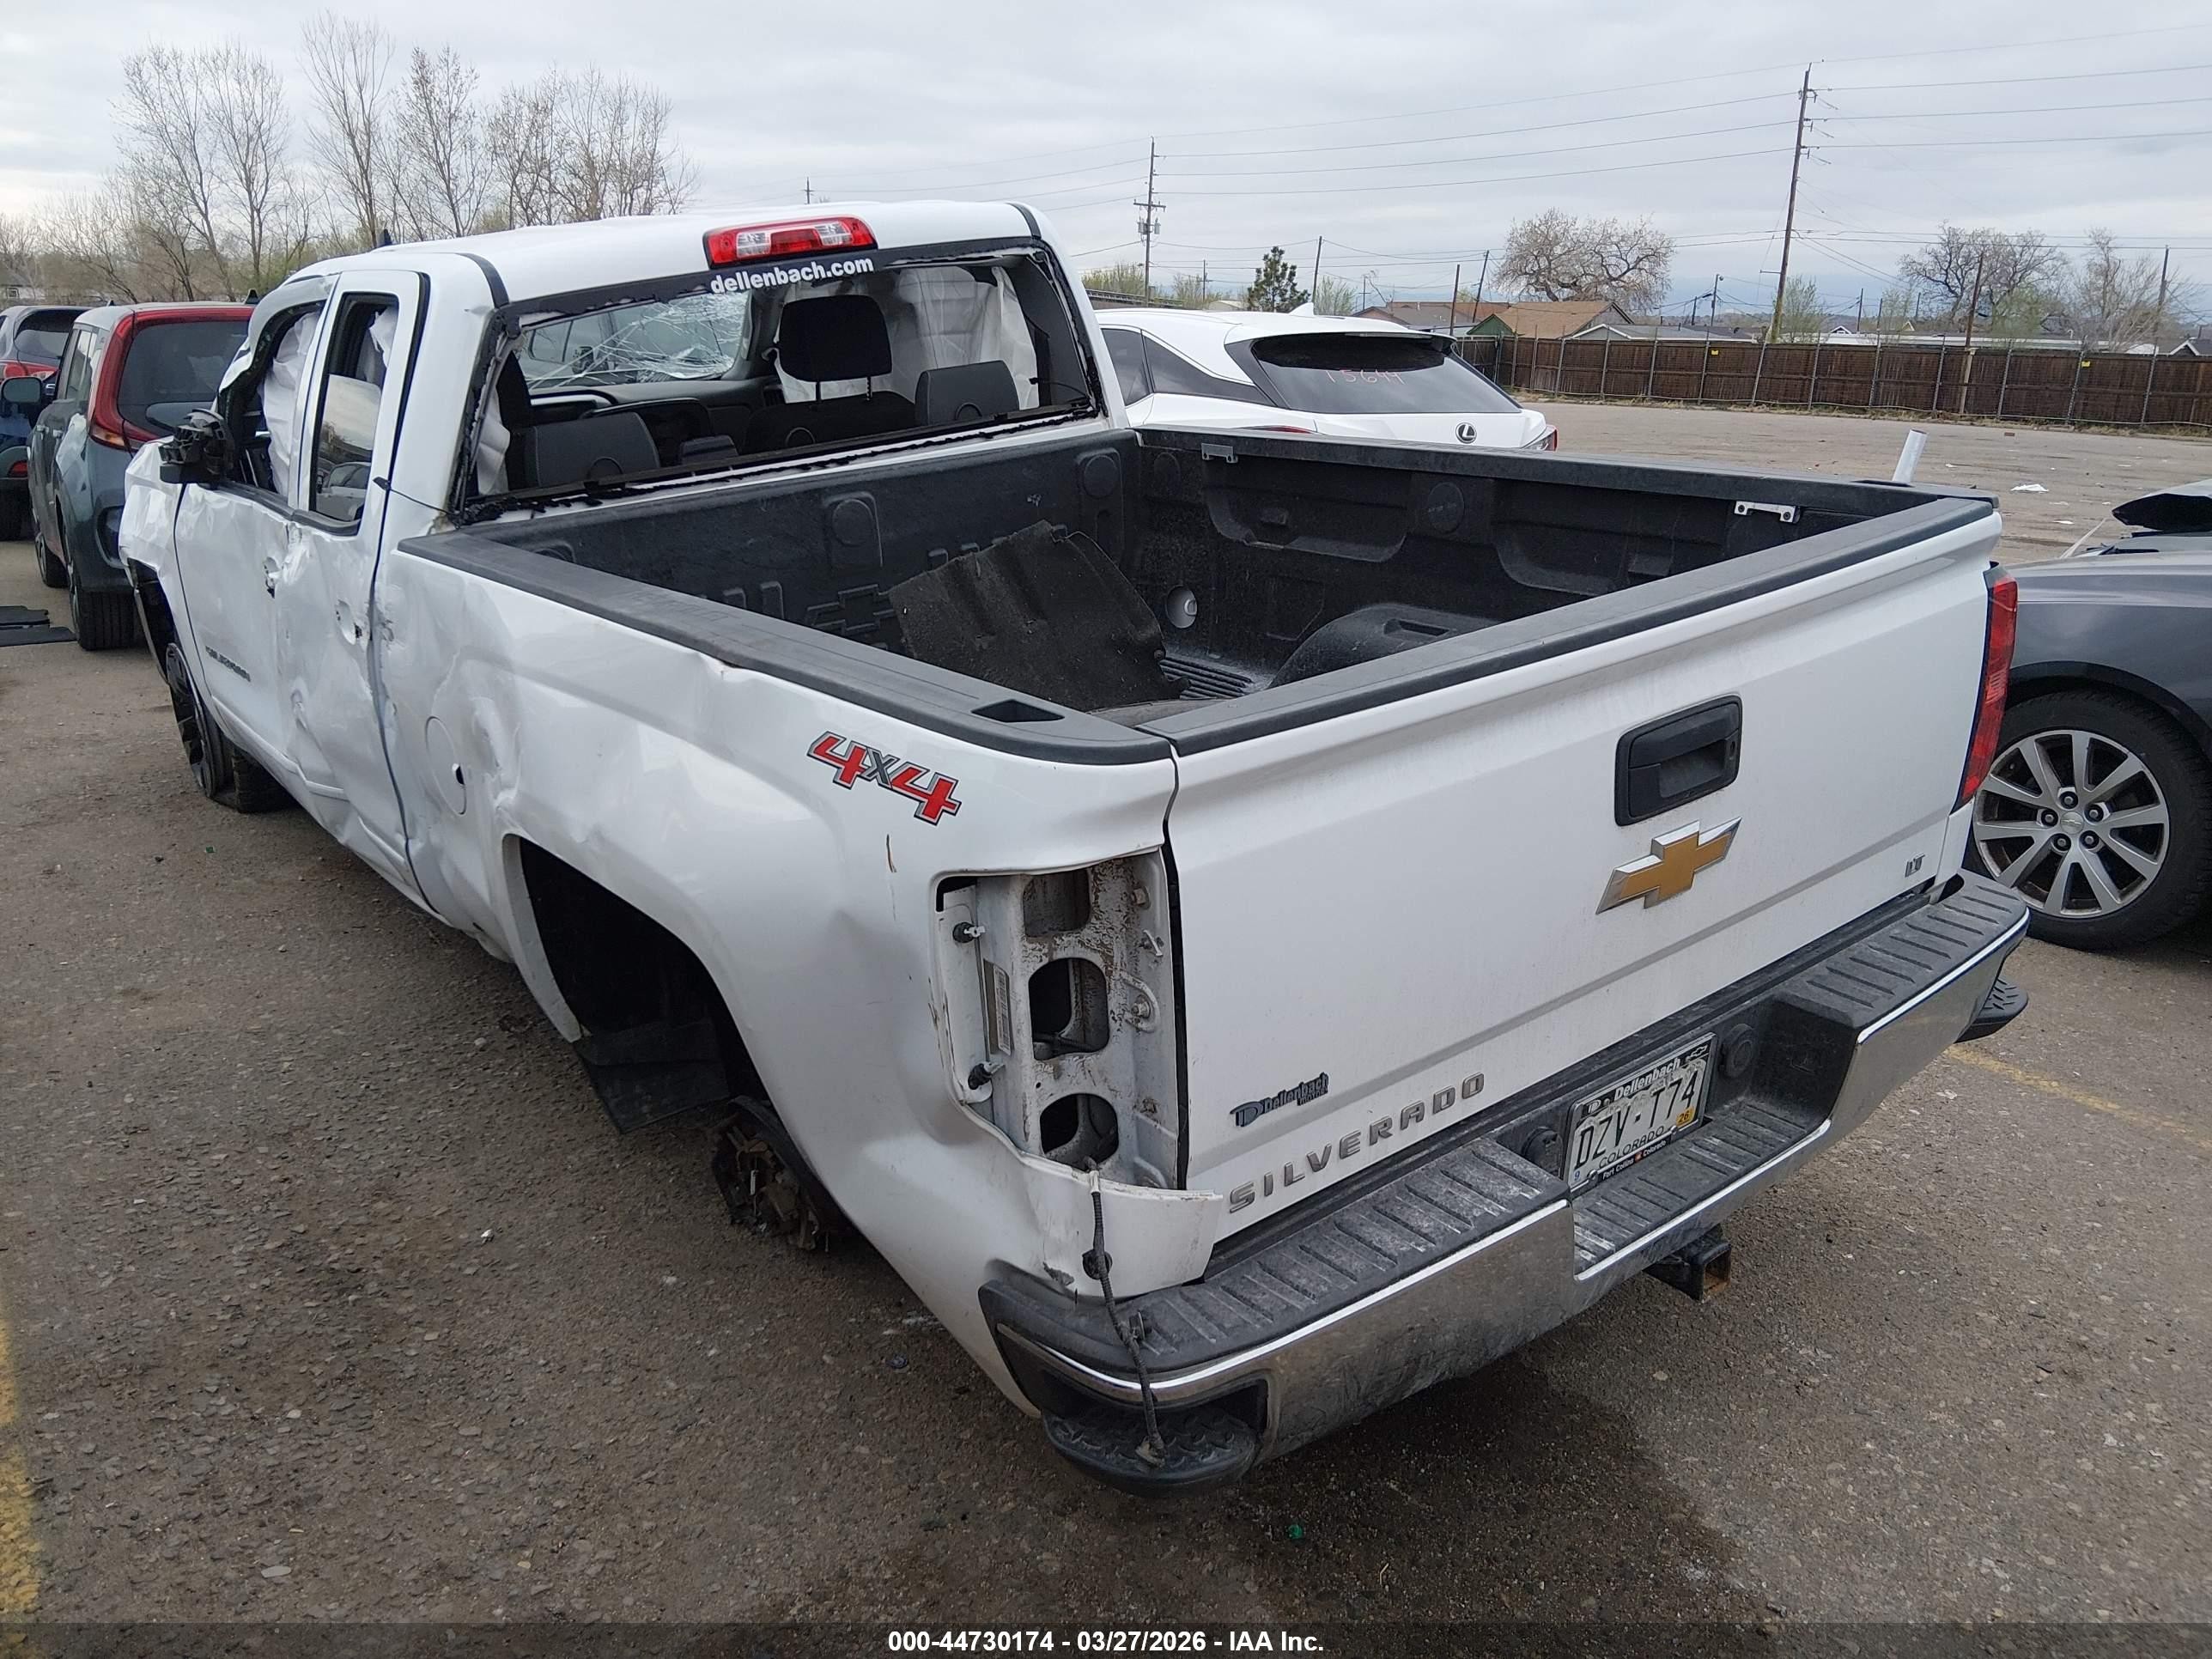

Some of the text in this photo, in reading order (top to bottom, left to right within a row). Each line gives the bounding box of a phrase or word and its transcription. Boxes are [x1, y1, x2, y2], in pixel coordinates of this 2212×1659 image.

[710, 258, 874, 294] dellenbach.com
[1905, 853, 1925, 878] LT
[1264, 1073, 1329, 1114] Dellenbach
[1614, 1057, 1680, 1100] Dellenbach
[1230, 1073, 1485, 1213] SILVERADO
[1599, 1126, 1664, 1168] COLORADO
[1603, 1139, 1667, 1180] Fort Collins Colorado
